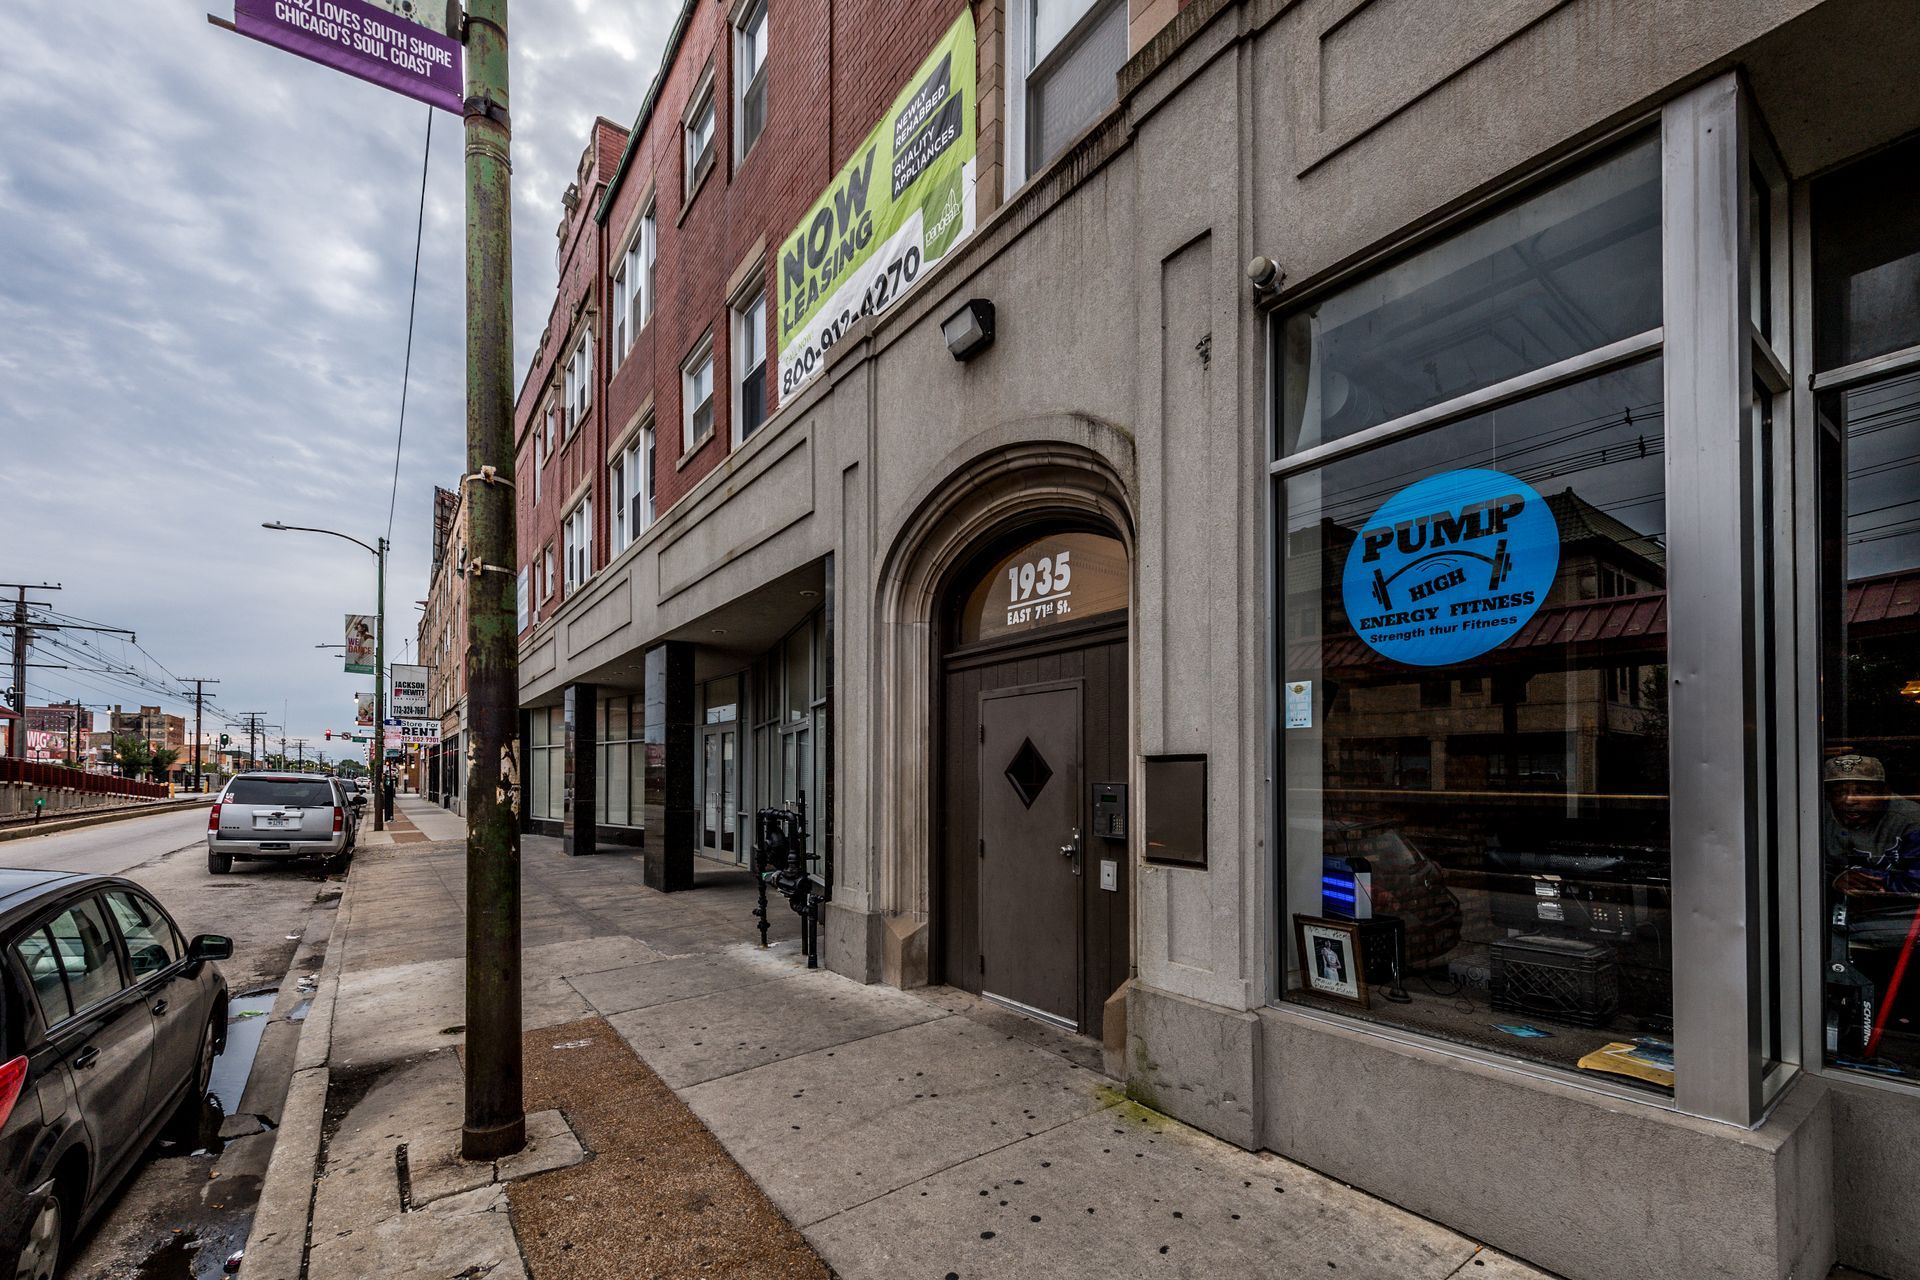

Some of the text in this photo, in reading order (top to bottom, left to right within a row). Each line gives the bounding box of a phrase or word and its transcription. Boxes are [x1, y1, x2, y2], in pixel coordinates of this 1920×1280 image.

[275, 1, 432, 77] CHICAGO'S SOUL COAST
[316, 0, 360, 31] LOVES
[363, 18, 407, 50] SOUTH
[410, 37, 452, 68] SHORE
[895, 84, 946, 149] REHABBED
[896, 88, 928, 134] NEWLY
[894, 126, 935, 178] QUALITY
[894, 124, 955, 194] APPLIANCES
[783, 143, 877, 301] NOW
[783, 210, 873, 337] LEASING
[783, 245, 921, 395] 800-912-4270
[1362, 493, 1525, 563] PUMP
[1008, 551, 1071, 602] 1935
[1408, 568, 1466, 602] HIGH
[1007, 607, 1032, 625] EAST
[1035, 602, 1053, 619] 71st
[1359, 591, 1536, 630] ENERGY FITNESS
[1369, 615, 1518, 644] Strength thur Fitness
[394, 681, 425, 689] JACKSON
[401, 727, 438, 737] RENT
[402, 720, 422, 728] Store
